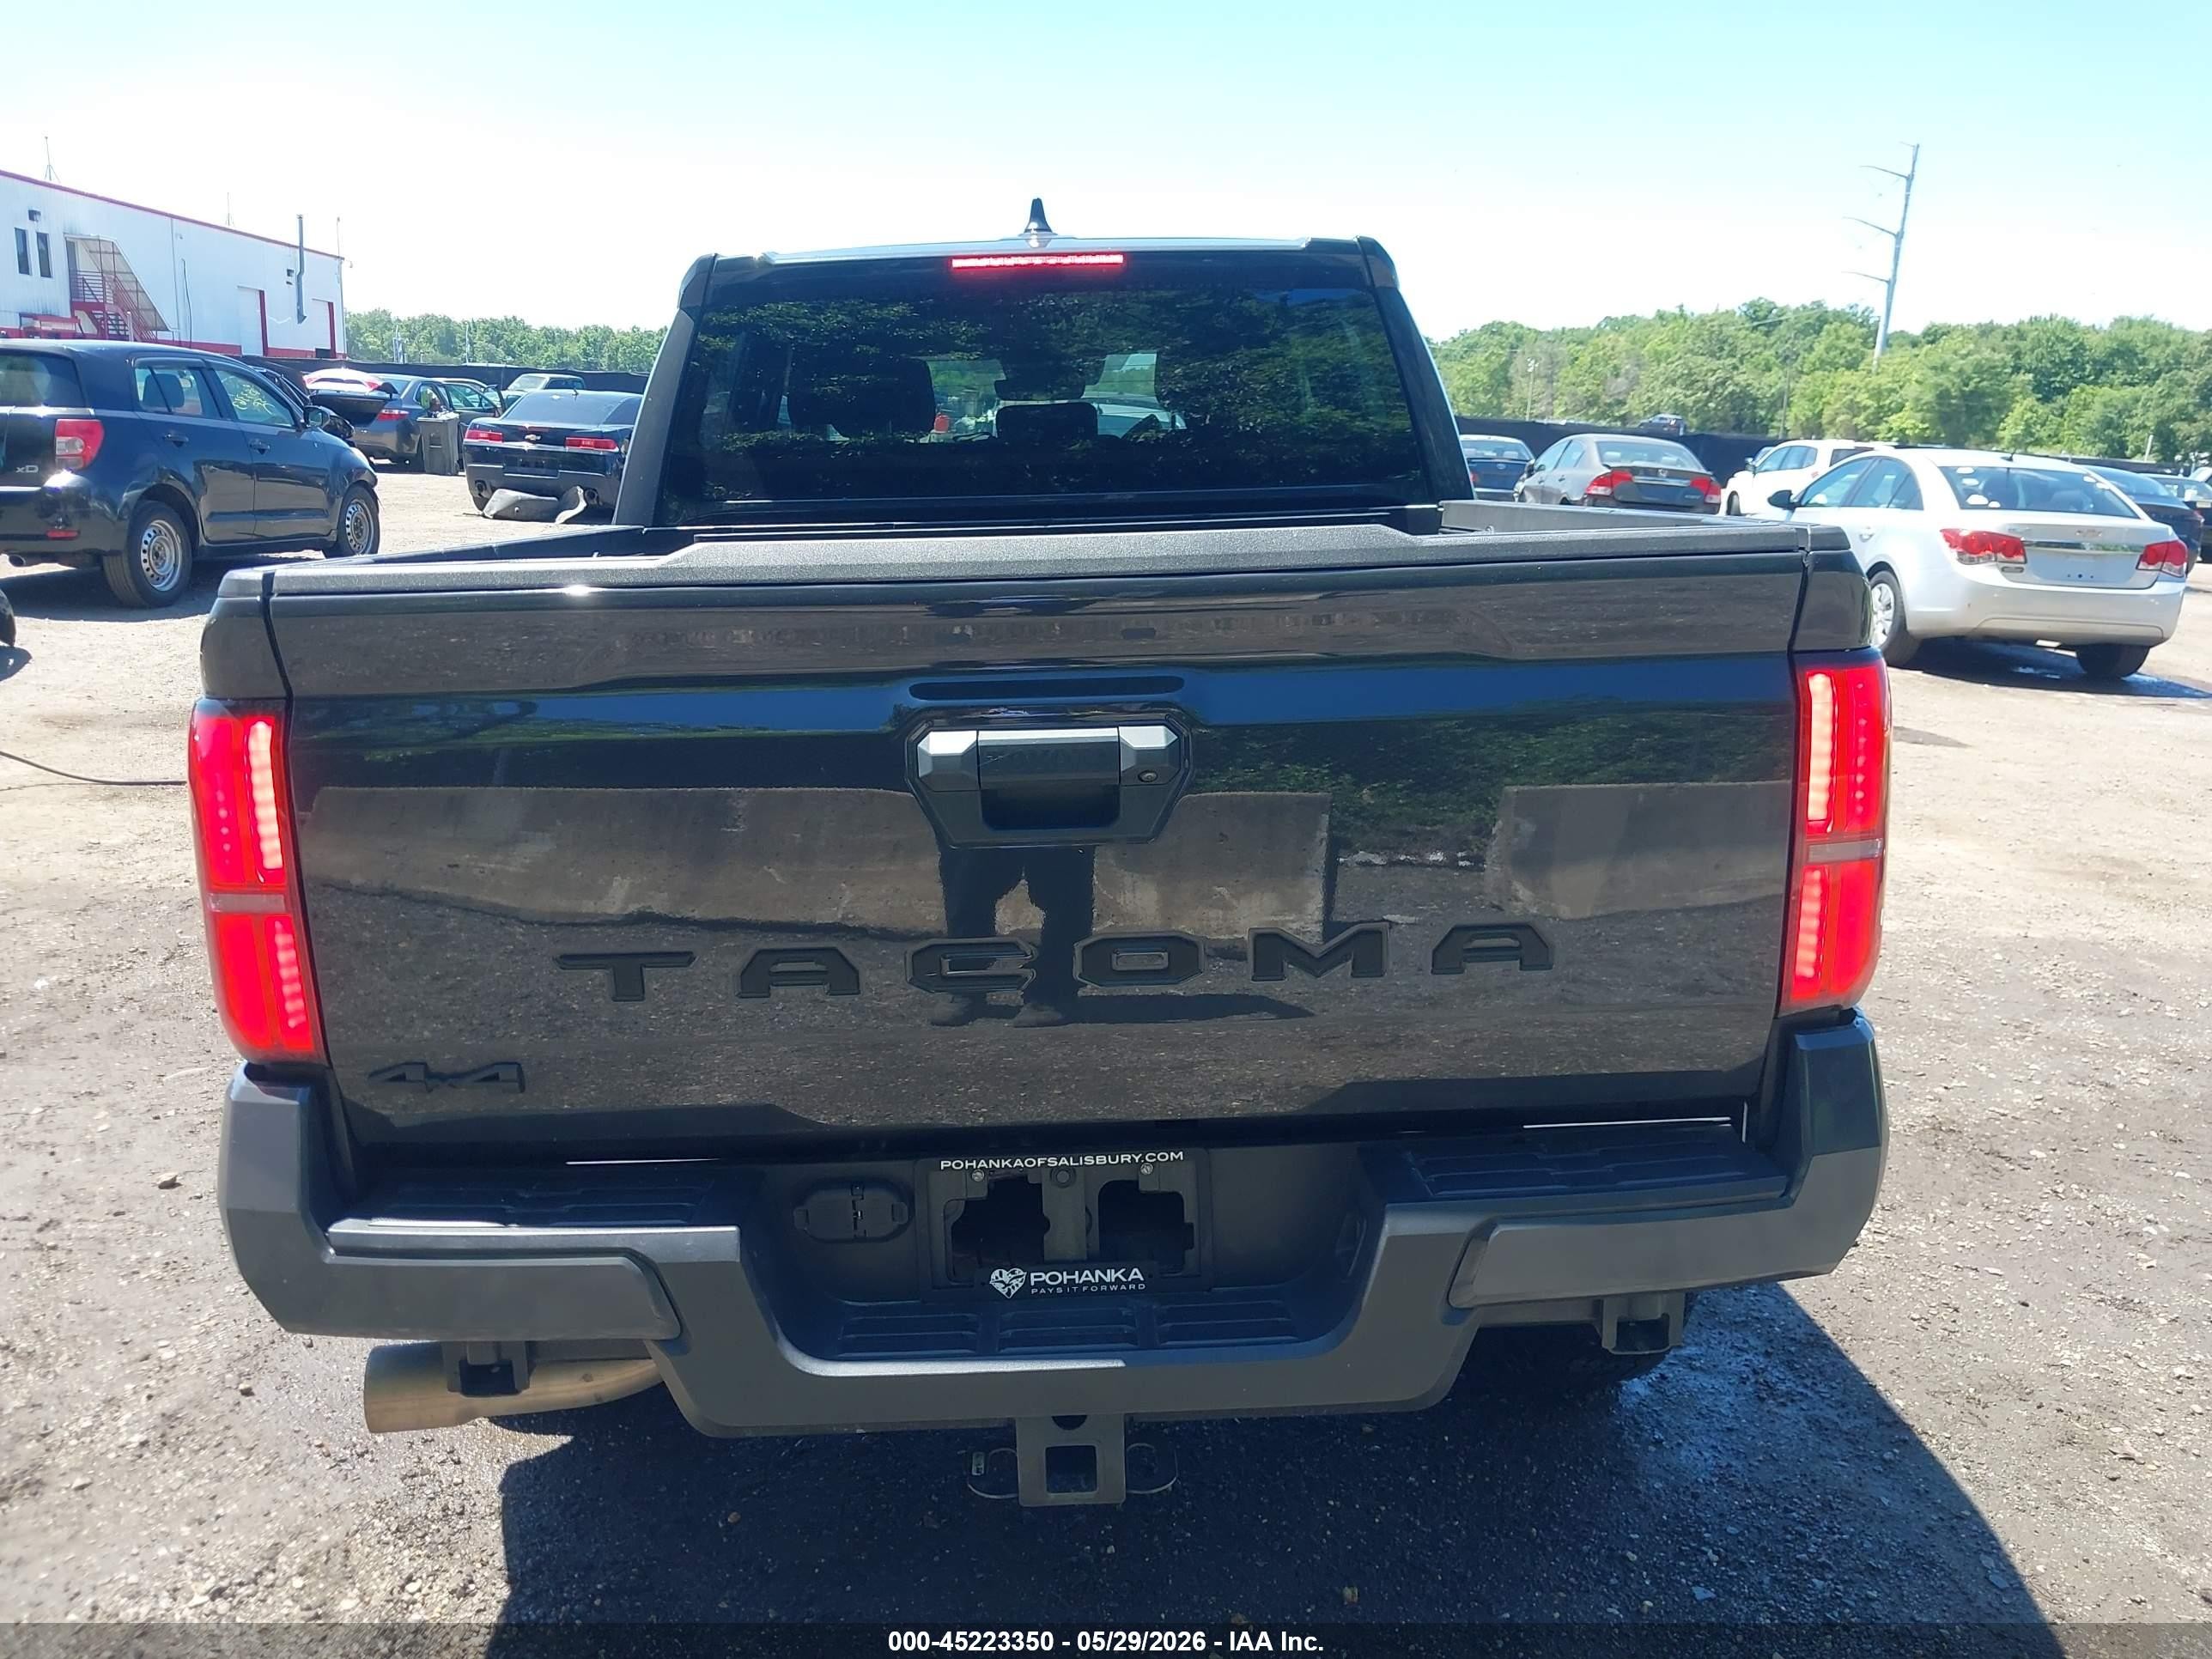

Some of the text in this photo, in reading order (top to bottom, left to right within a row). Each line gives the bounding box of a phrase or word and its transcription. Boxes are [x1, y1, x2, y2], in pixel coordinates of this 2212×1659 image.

[15, 465, 40, 474] xD
[553, 921, 1555, 1002] TACOMA
[939, 1151, 1184, 1170] POHANKAOFSALISBURY.COM
[1030, 1267, 1145, 1286] POHANKA
[1030, 1286, 1063, 1295] PAYS
[1082, 1283, 1146, 1292] FORWARD
